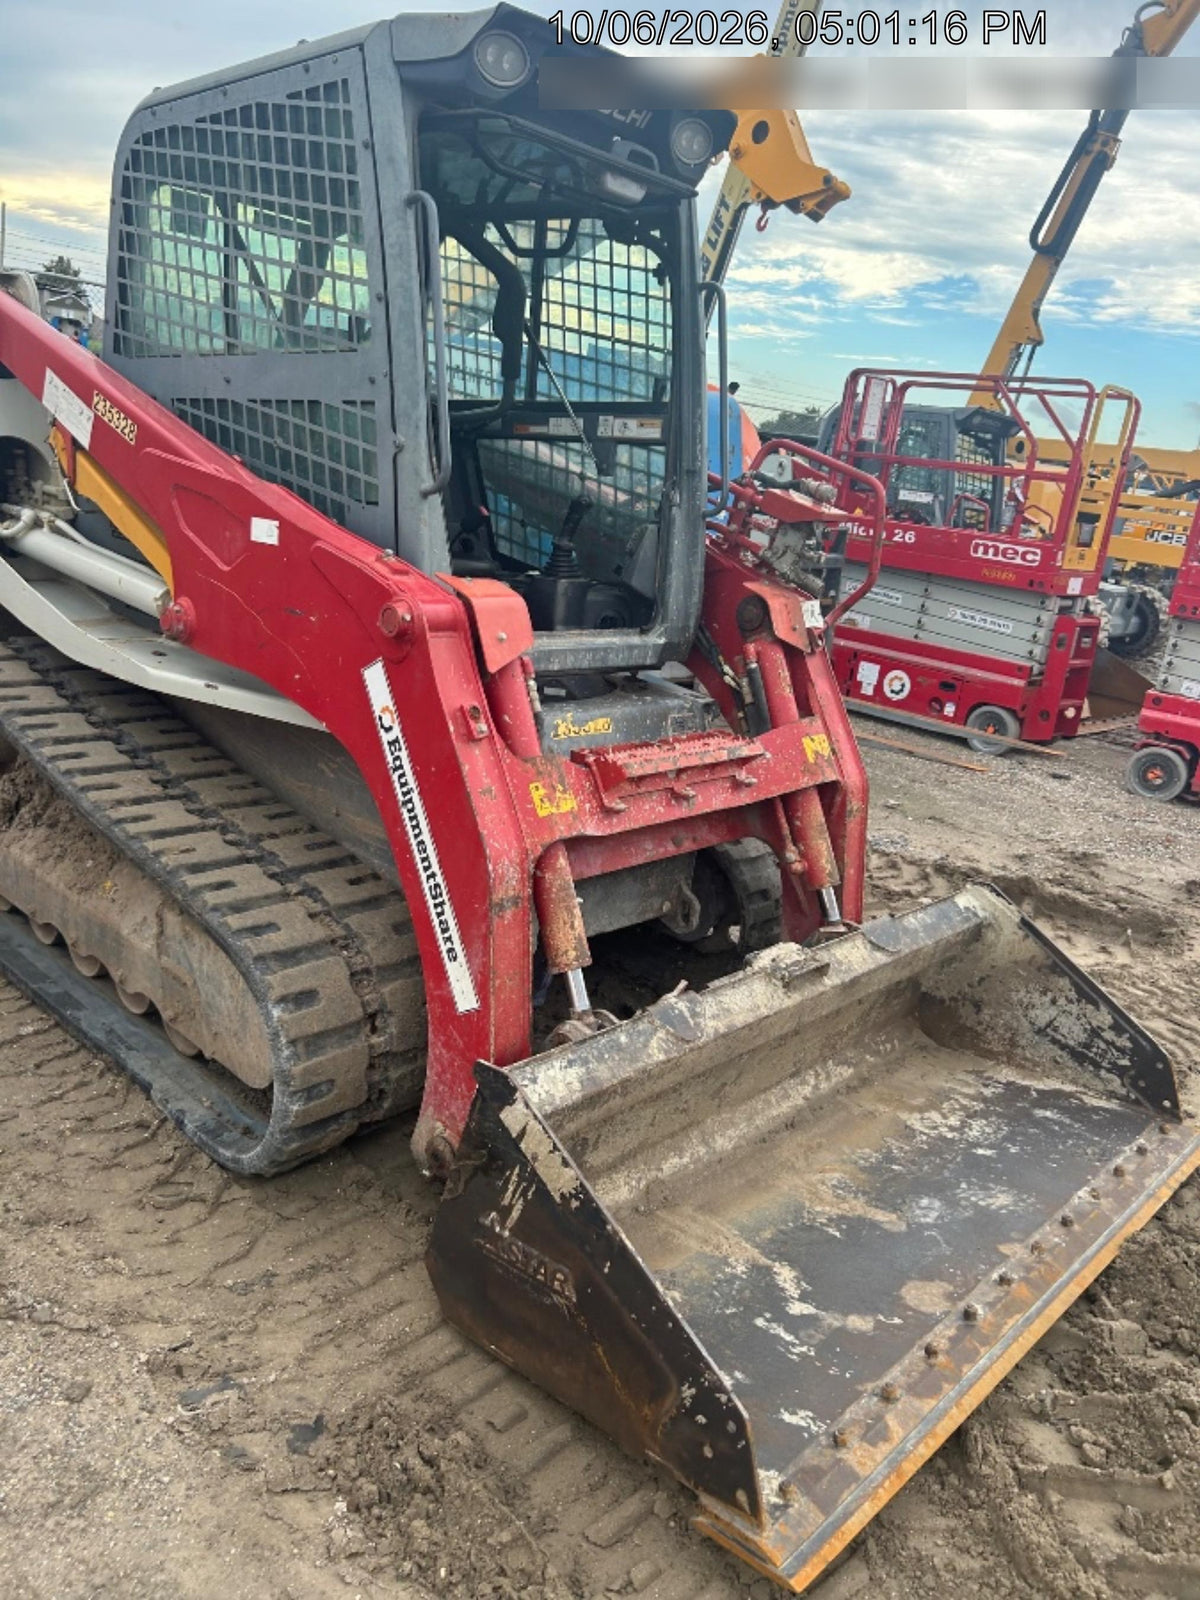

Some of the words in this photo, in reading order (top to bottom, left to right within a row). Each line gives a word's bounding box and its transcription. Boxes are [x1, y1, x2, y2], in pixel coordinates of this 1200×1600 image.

[706, 192, 731, 252] LIFT
[93, 391, 136, 443] 235328
[892, 529, 917, 543] 26
[972, 541, 1040, 564] mec
[1146, 529, 1187, 546] JCB
[385, 734, 458, 964] EquipmentShare
